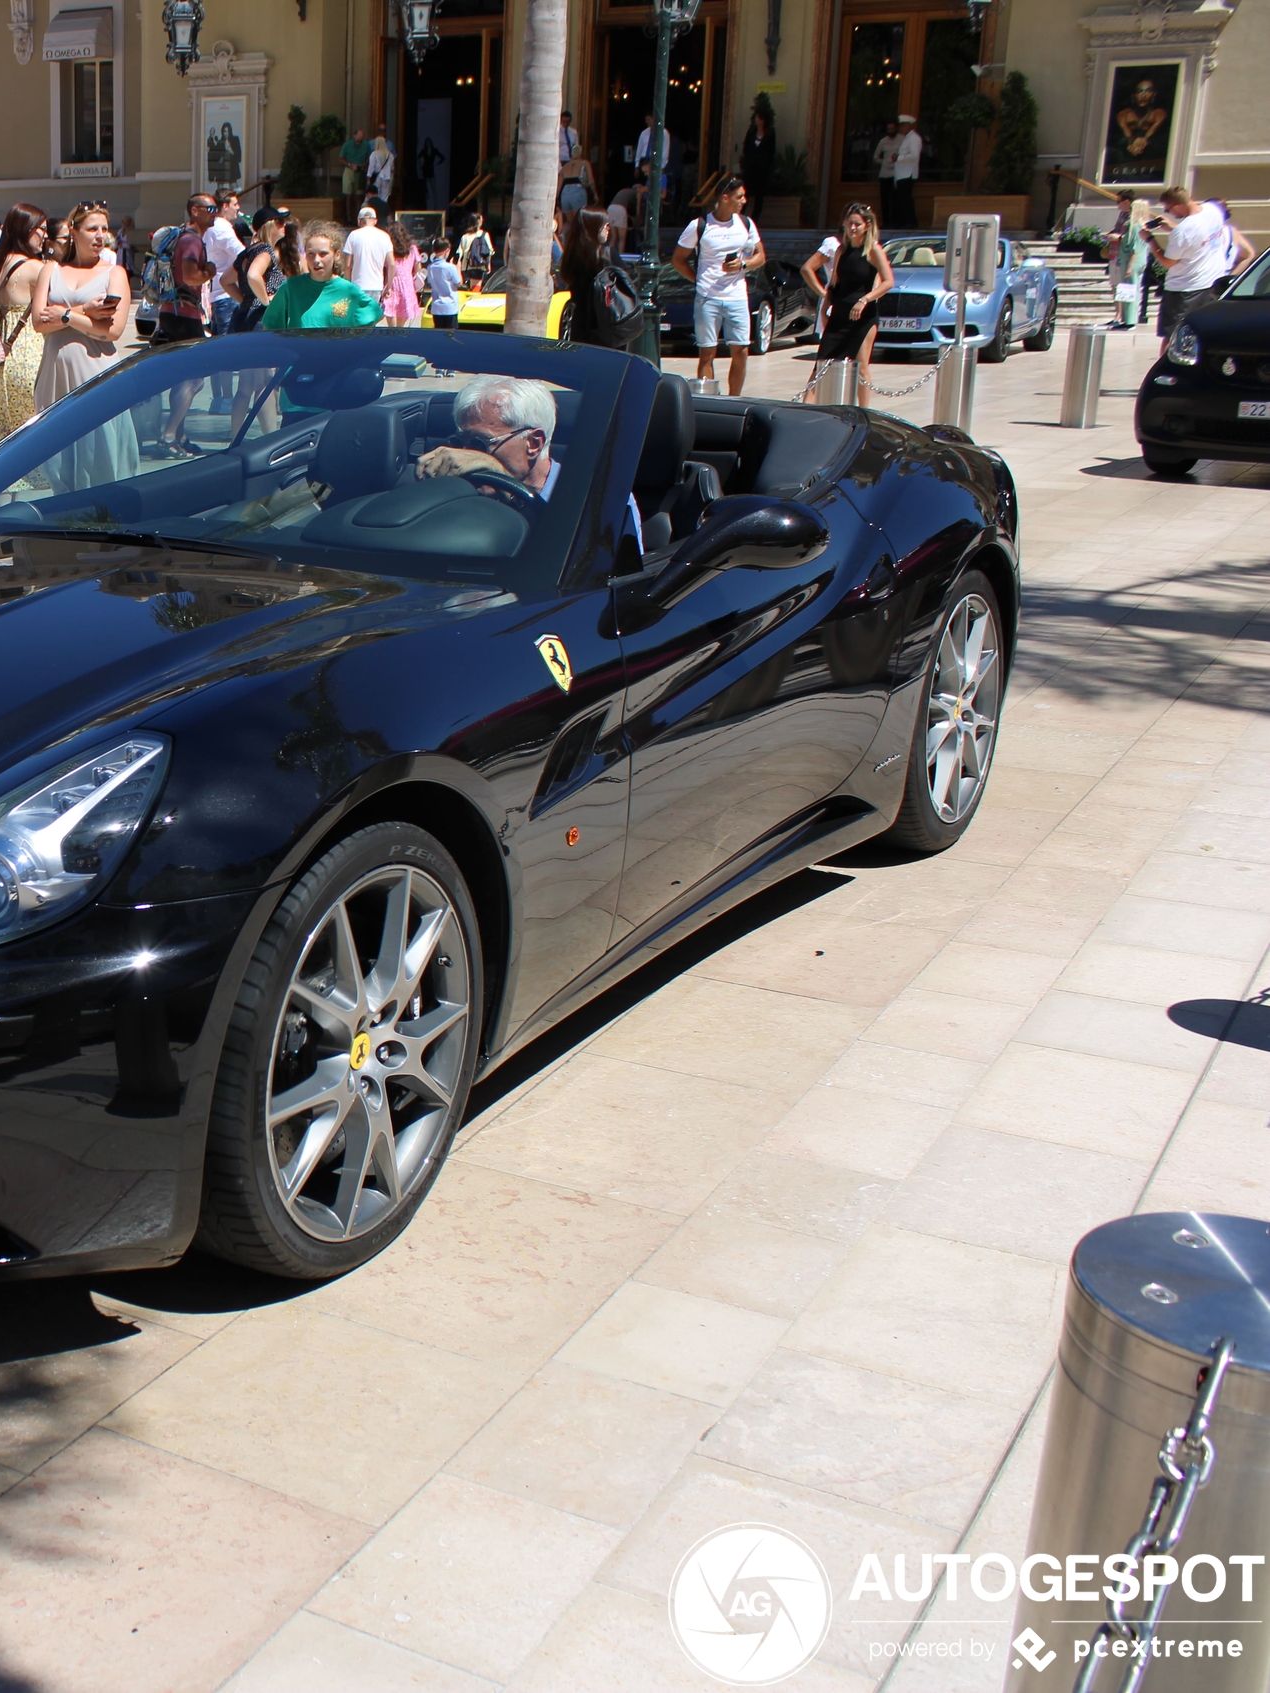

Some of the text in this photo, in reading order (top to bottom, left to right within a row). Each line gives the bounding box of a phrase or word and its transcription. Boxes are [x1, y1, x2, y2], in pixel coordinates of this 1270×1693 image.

[54, 48, 82, 58] OMEGA
[73, 166, 99, 176] OMEGA
[1112, 165, 1156, 175] GRAFF
[1250, 404, 1270, 417] 22
[389, 844, 448, 873] P ZERO
